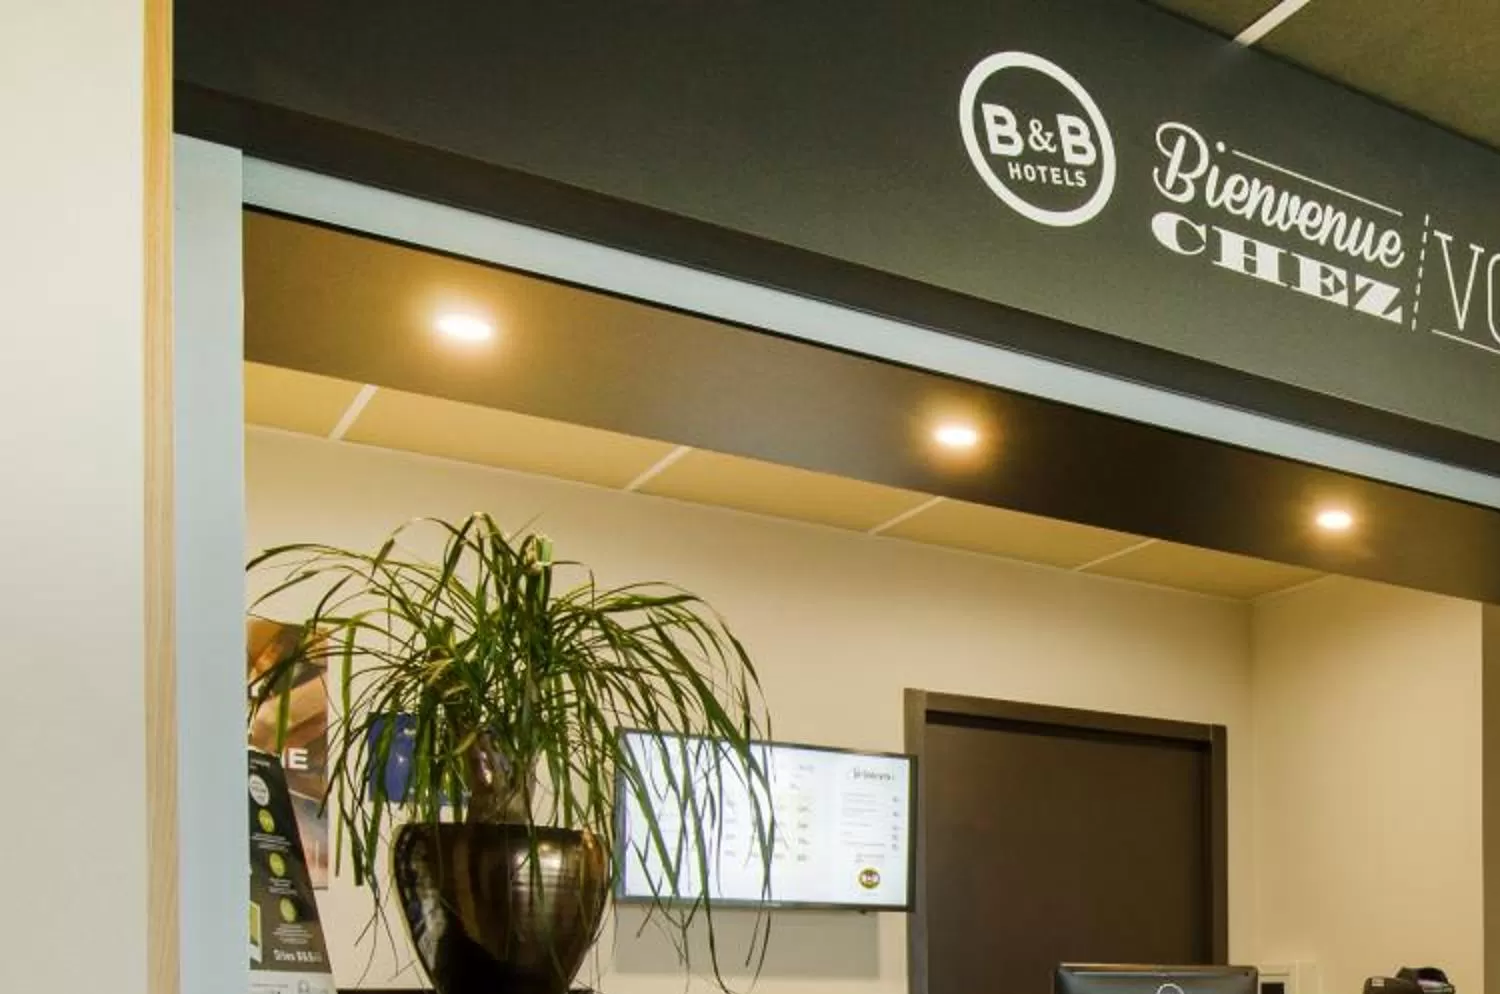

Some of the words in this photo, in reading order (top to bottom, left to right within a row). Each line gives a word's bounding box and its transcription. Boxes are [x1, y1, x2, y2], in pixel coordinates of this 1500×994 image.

[982, 103, 1096, 166] B&B
[1008, 161, 1087, 188] HOTELS
[1153, 122, 1404, 268] Bienvenue
[1152, 211, 1402, 324] CHEZ
